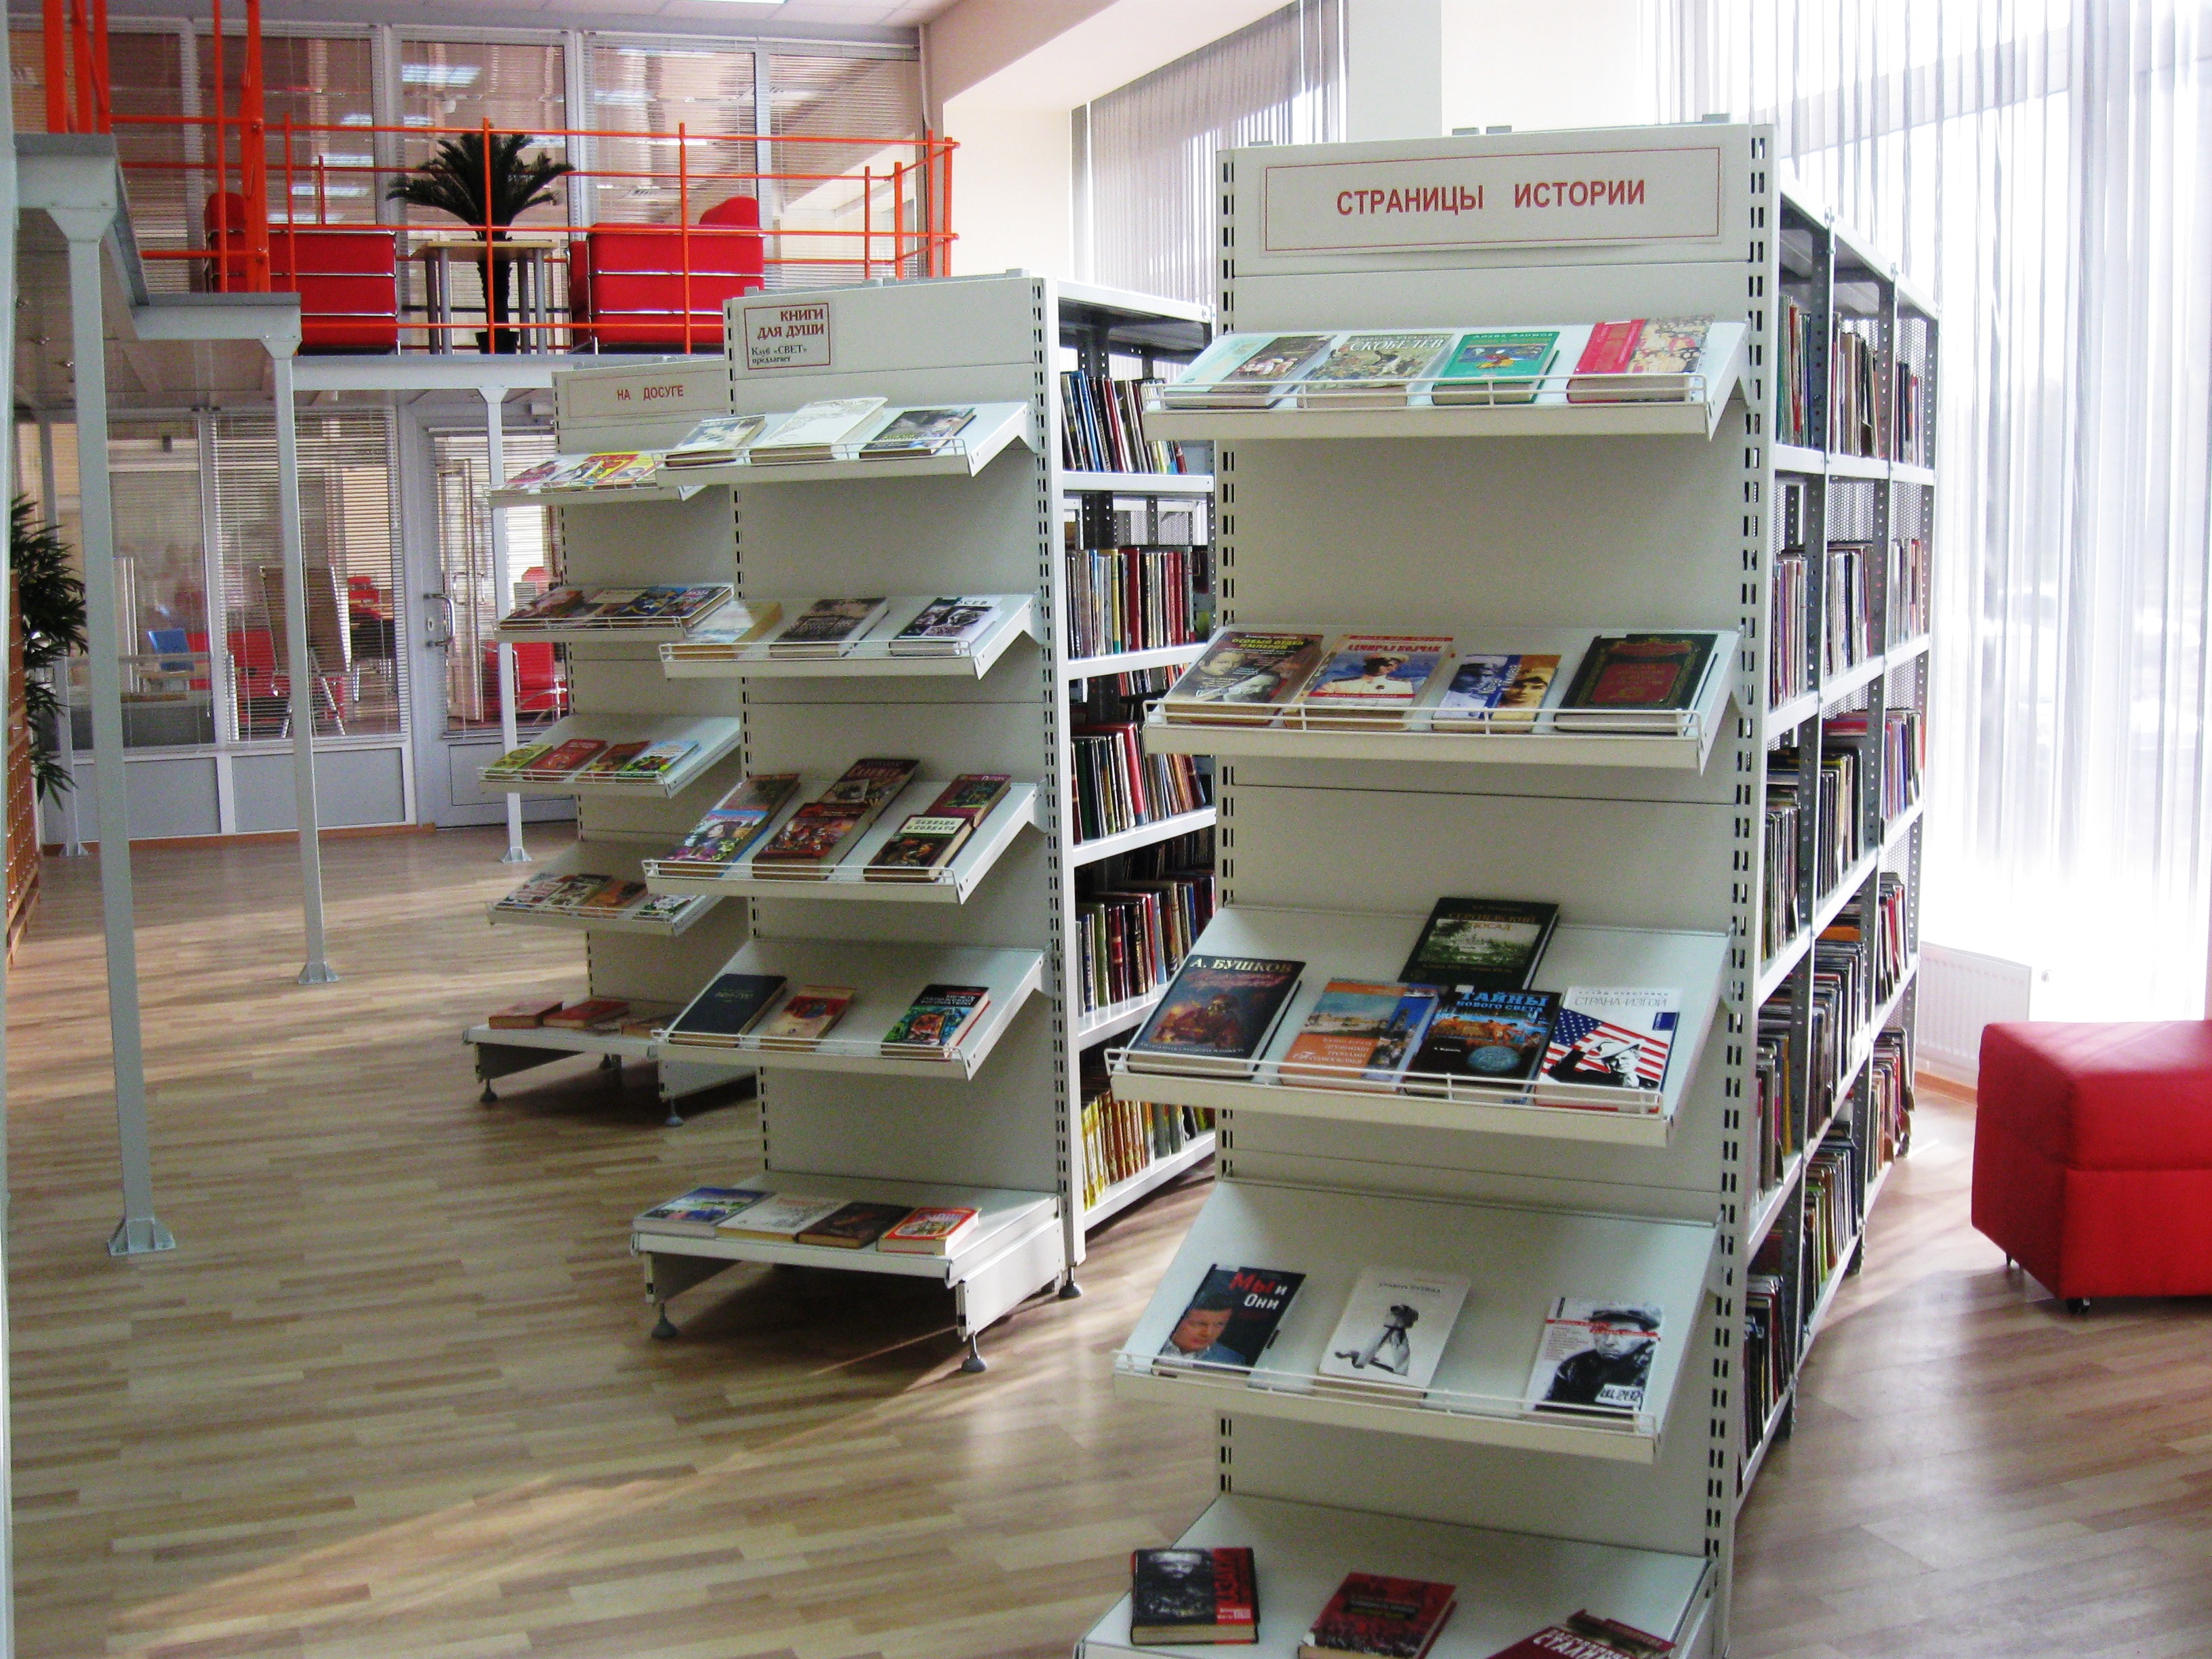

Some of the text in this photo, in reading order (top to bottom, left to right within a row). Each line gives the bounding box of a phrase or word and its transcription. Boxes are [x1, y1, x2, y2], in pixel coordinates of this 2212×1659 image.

[1337, 180, 1645, 216] СТРАНИЦЫ ИСТОРИИ
[781, 309, 823, 322] КНИГИ
[757, 324, 824, 340] ДЛЯ ДУШИ
[752, 344, 807, 356] Клуб «СВЕТ»
[1350, 339, 1444, 351] СКОБЕЛЕВ
[752, 356, 791, 365] предлагает
[617, 386, 684, 401] НА ДОСУГЕ
[1189, 958, 1293, 972] А. БУШКОВ
[1461, 991, 1551, 1006] ТАЙНЫ
[1456, 1000, 1544, 1013] НОВОГО СВЕТА
[1228, 1272, 1288, 1296] Мы и
[1244, 1293, 1279, 1310] Они
